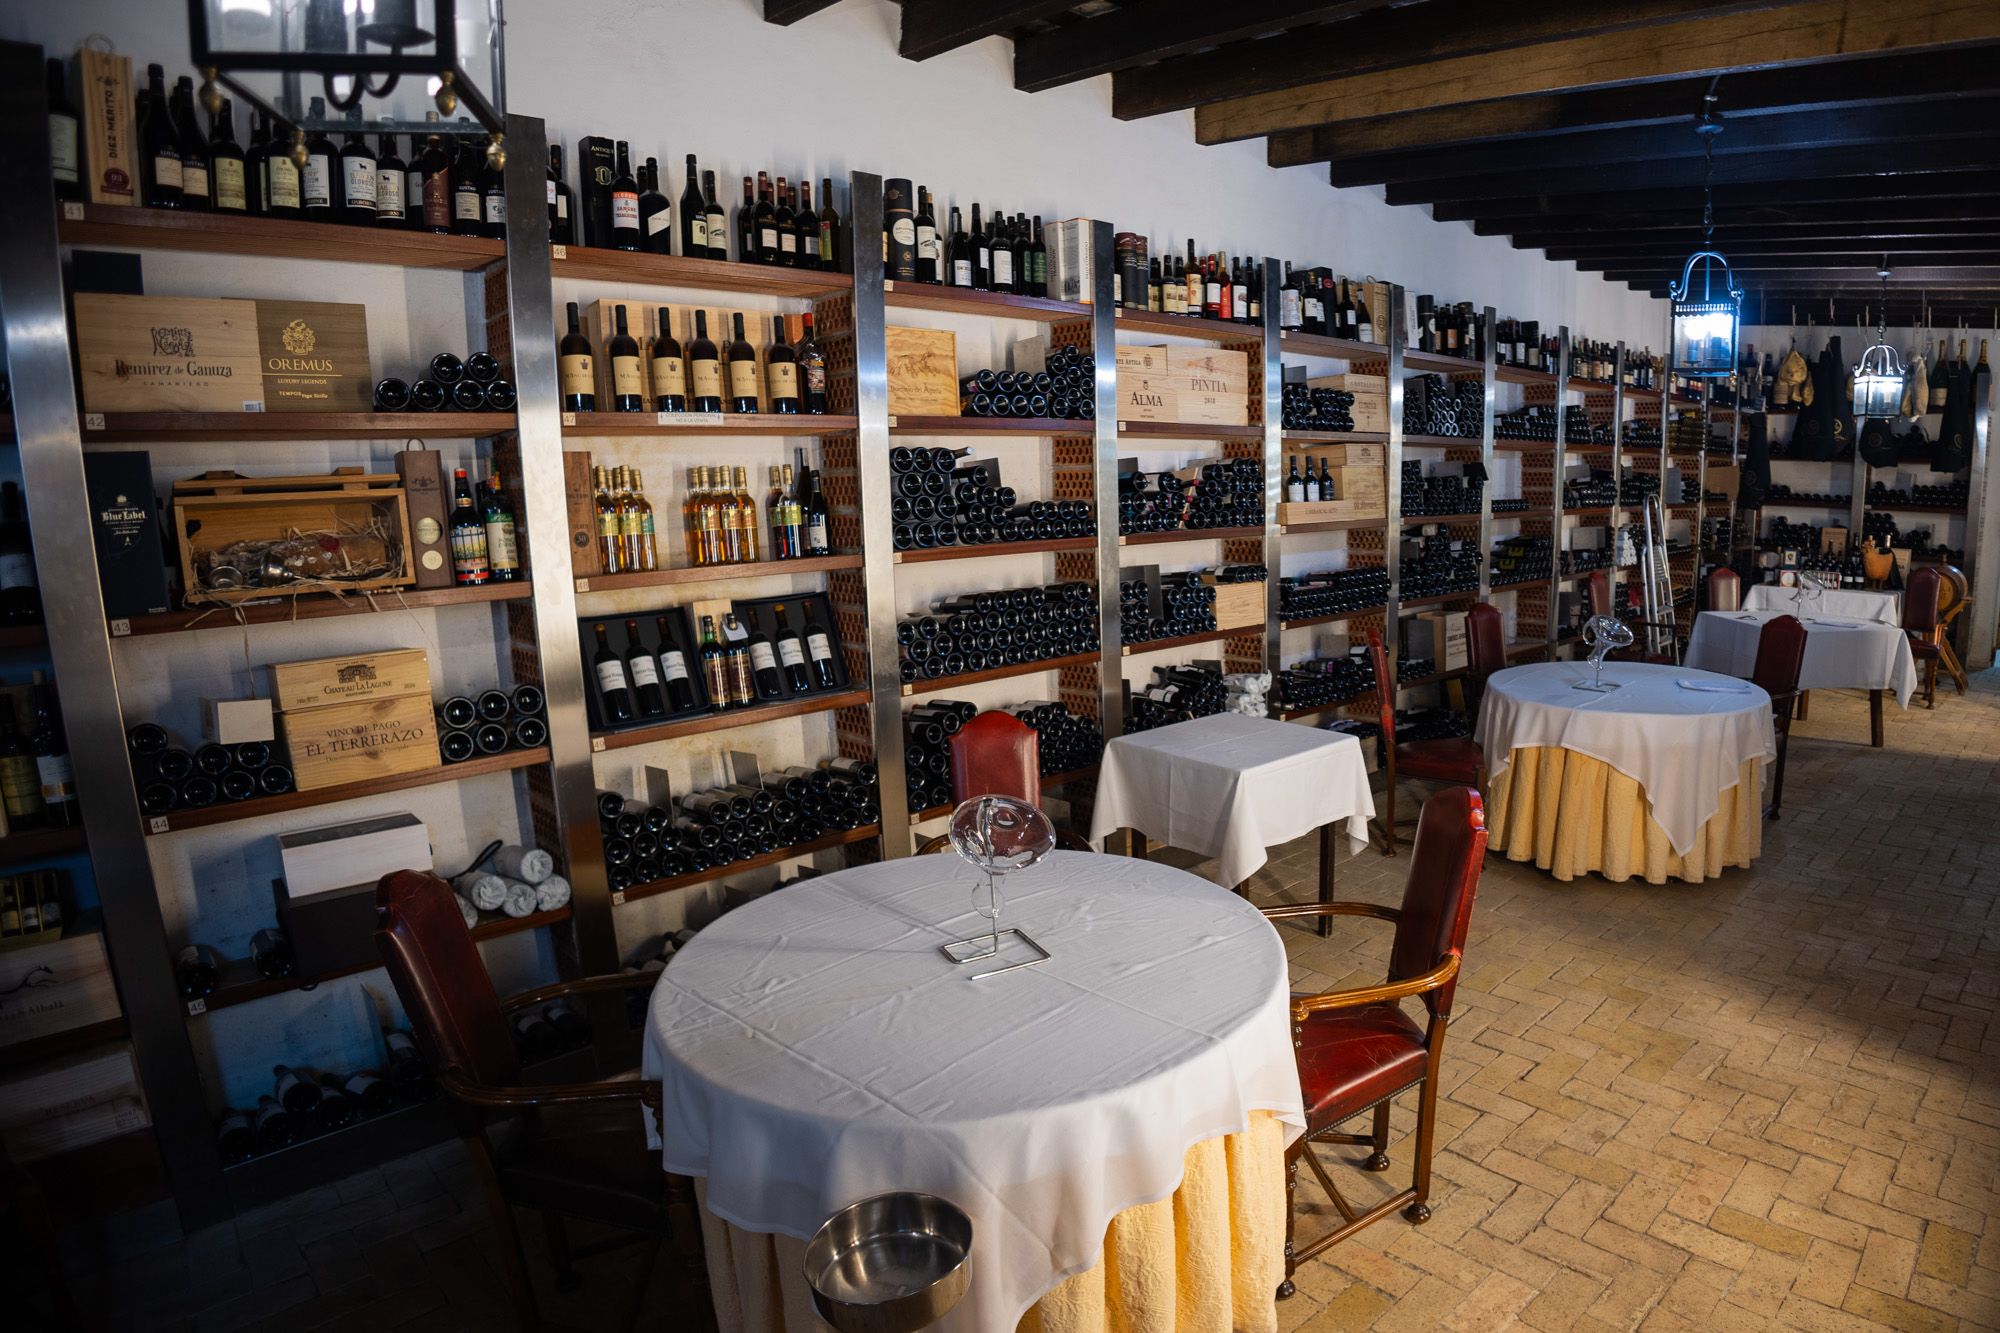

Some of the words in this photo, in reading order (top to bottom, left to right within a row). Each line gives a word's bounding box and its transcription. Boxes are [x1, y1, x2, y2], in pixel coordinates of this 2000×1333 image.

[66, 206, 82, 217] 41
[174, 366, 184, 375] de
[186, 360, 233, 378] Ganuza
[268, 358, 333, 372] OREMUS
[1191, 378, 1228, 393] PINTIA
[1130, 391, 1164, 407] ALMA
[88, 416, 104, 427] 42
[101, 511, 122, 522] Blue
[123, 510, 146, 520] Label
[113, 622, 130, 633] 43
[365, 680, 393, 690] LAGUNE
[326, 727, 354, 738] VINO
[355, 724, 369, 735] DE
[373, 720, 401, 732] PAGO
[305, 743, 325, 757] EL
[329, 727, 424, 753] TERRERAZO
[152, 818, 168, 831] 44
[190, 1002, 205, 1013] 45
